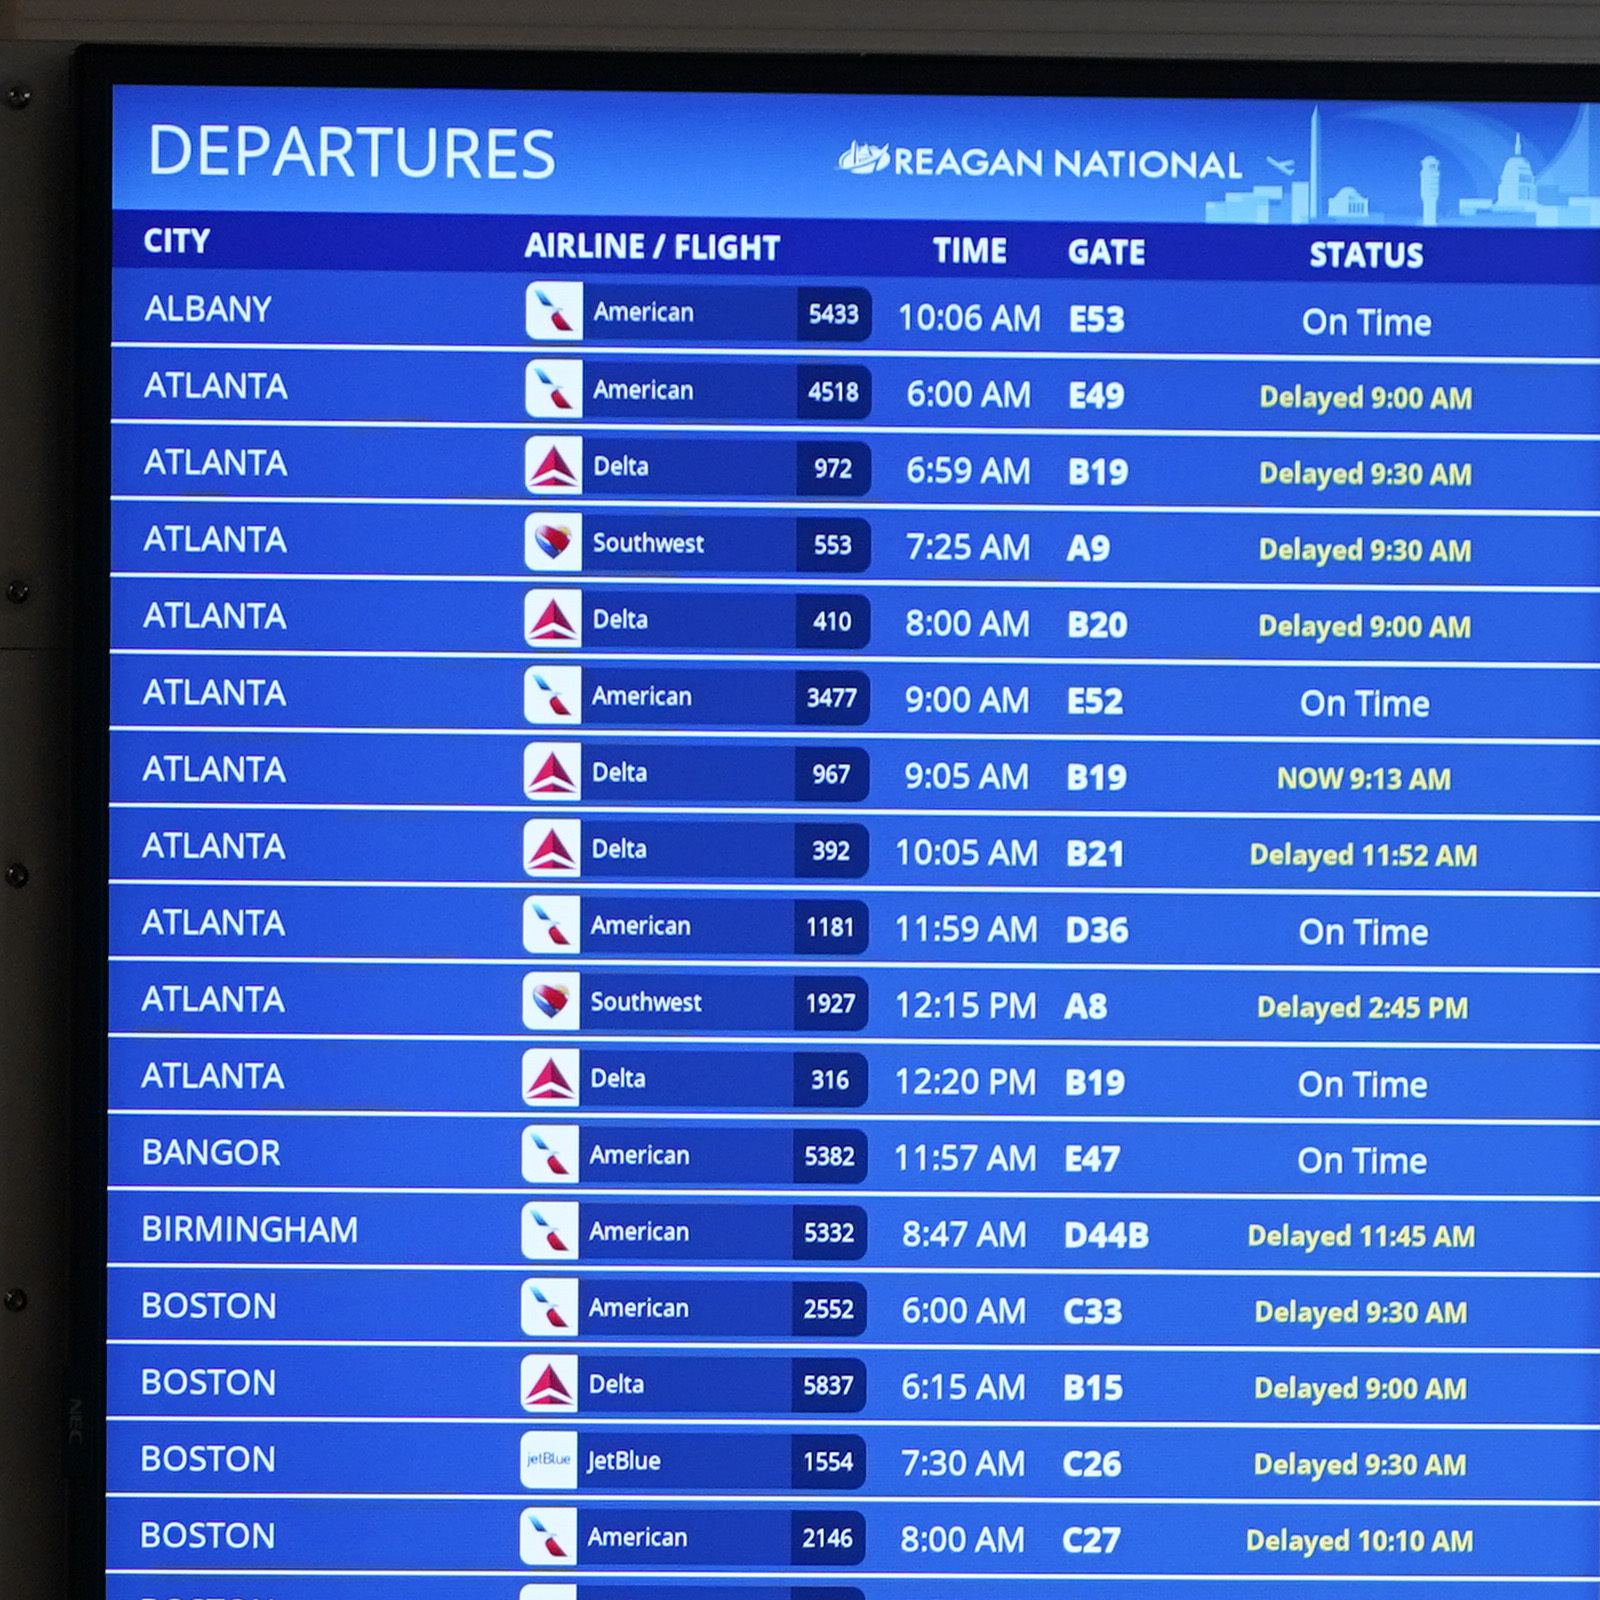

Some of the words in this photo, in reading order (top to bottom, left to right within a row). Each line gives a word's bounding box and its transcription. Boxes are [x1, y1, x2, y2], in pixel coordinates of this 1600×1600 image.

[151, 124, 555, 180] DEPARTURES
[895, 147, 1043, 177] REAGAN
[1054, 149, 1243, 180] NATIONAL
[144, 227, 211, 254] CITY
[524, 231, 645, 260] AIRLINE
[652, 233, 667, 260] /
[675, 233, 781, 261] FLIGHT
[932, 236, 1007, 264] TIME
[1068, 238, 1145, 266] GATE
[1310, 241, 1424, 269] STATUS
[144, 294, 272, 323] ALBANY
[593, 300, 694, 323] American
[809, 303, 859, 325] 5433
[899, 303, 983, 332] 10:06
[990, 304, 1041, 332] AM
[1069, 304, 1125, 333] E53
[1302, 307, 1348, 336] On
[1356, 308, 1432, 337] Time
[143, 524, 288, 553] ATLANTA
[593, 531, 705, 554] Southwest
[814, 534, 852, 556] 553
[906, 532, 972, 561] 7:25
[979, 533, 1030, 561] AM
[1066, 534, 1111, 562] A9
[1259, 536, 1363, 568] Delayed
[1370, 538, 1423, 562] 9:30
[1428, 539, 1472, 563] AM
[142, 1215, 358, 1243] BIRMINGHAM
[589, 1220, 690, 1242] American
[804, 1222, 855, 1243] 5332
[902, 1220, 968, 1248] 8:47
[975, 1220, 1026, 1248] AM
[1065, 1221, 1150, 1249] D44B
[1248, 1222, 1352, 1254] Delayed
[1360, 1224, 1427, 1248] 11:45
[1432, 1225, 1475, 1248] AM
[69, 1398, 83, 1445] NEC
[141, 1445, 275, 1472] BOSTON
[585, 1449, 661, 1475] JetBlue
[804, 1451, 854, 1472] 1554
[901, 1449, 967, 1477] 7:30
[974, 1449, 1025, 1477] AM
[1062, 1450, 1122, 1478] C26
[1254, 1451, 1358, 1483] Delayed
[1364, 1453, 1418, 1476] 9:30
[1423, 1453, 1467, 1477] AM
